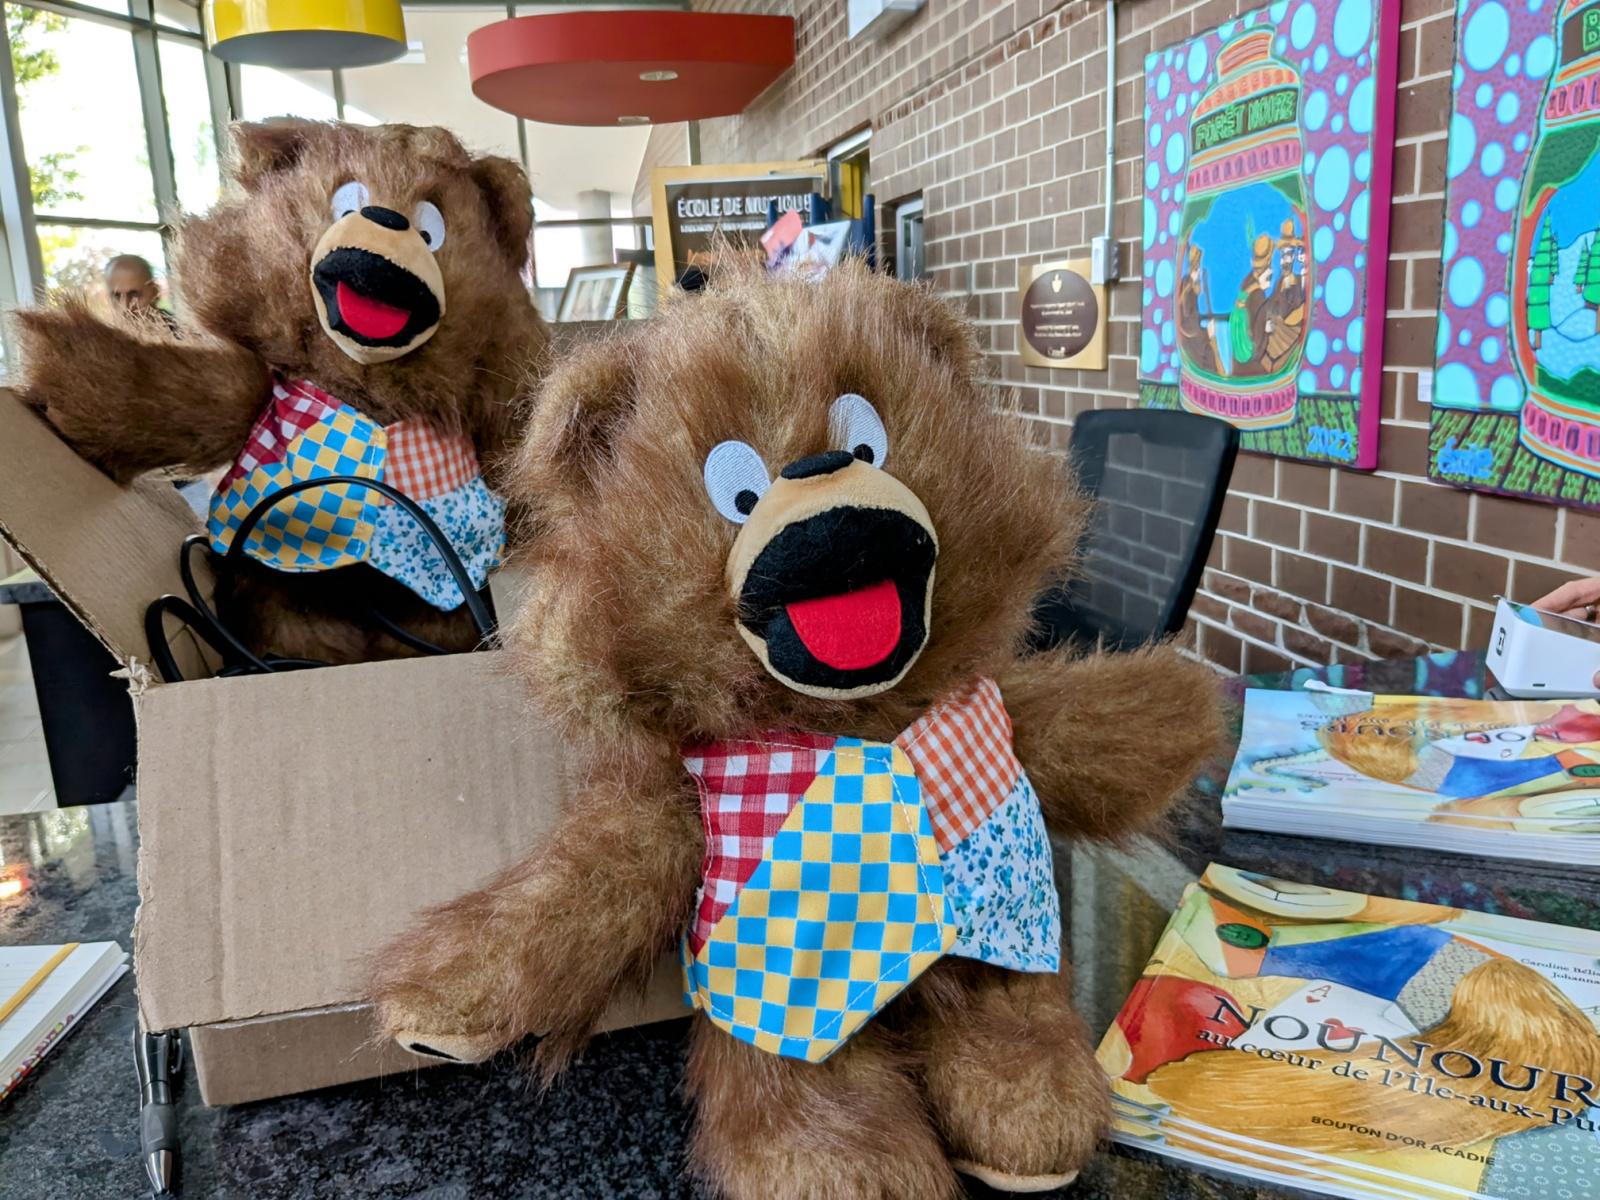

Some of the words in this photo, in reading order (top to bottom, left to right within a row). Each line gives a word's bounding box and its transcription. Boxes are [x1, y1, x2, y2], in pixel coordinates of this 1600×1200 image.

[677, 196, 721, 218] ÉCOLE
[722, 196, 743, 217] DE
[1305, 424, 1351, 460] 2022
[1520, 957, 1570, 972] Caroline
[1198, 1029, 1237, 1050] au
[1241, 1043, 1323, 1070] cœur
[1332, 1061, 1370, 1081] de
[1379, 1068, 1600, 1132] l'Île-aux-Pu
[1311, 1115, 1382, 1138] BOUTON
[1385, 1132, 1427, 1149] D'OR
[1429, 1144, 1496, 1167] ACADIE
